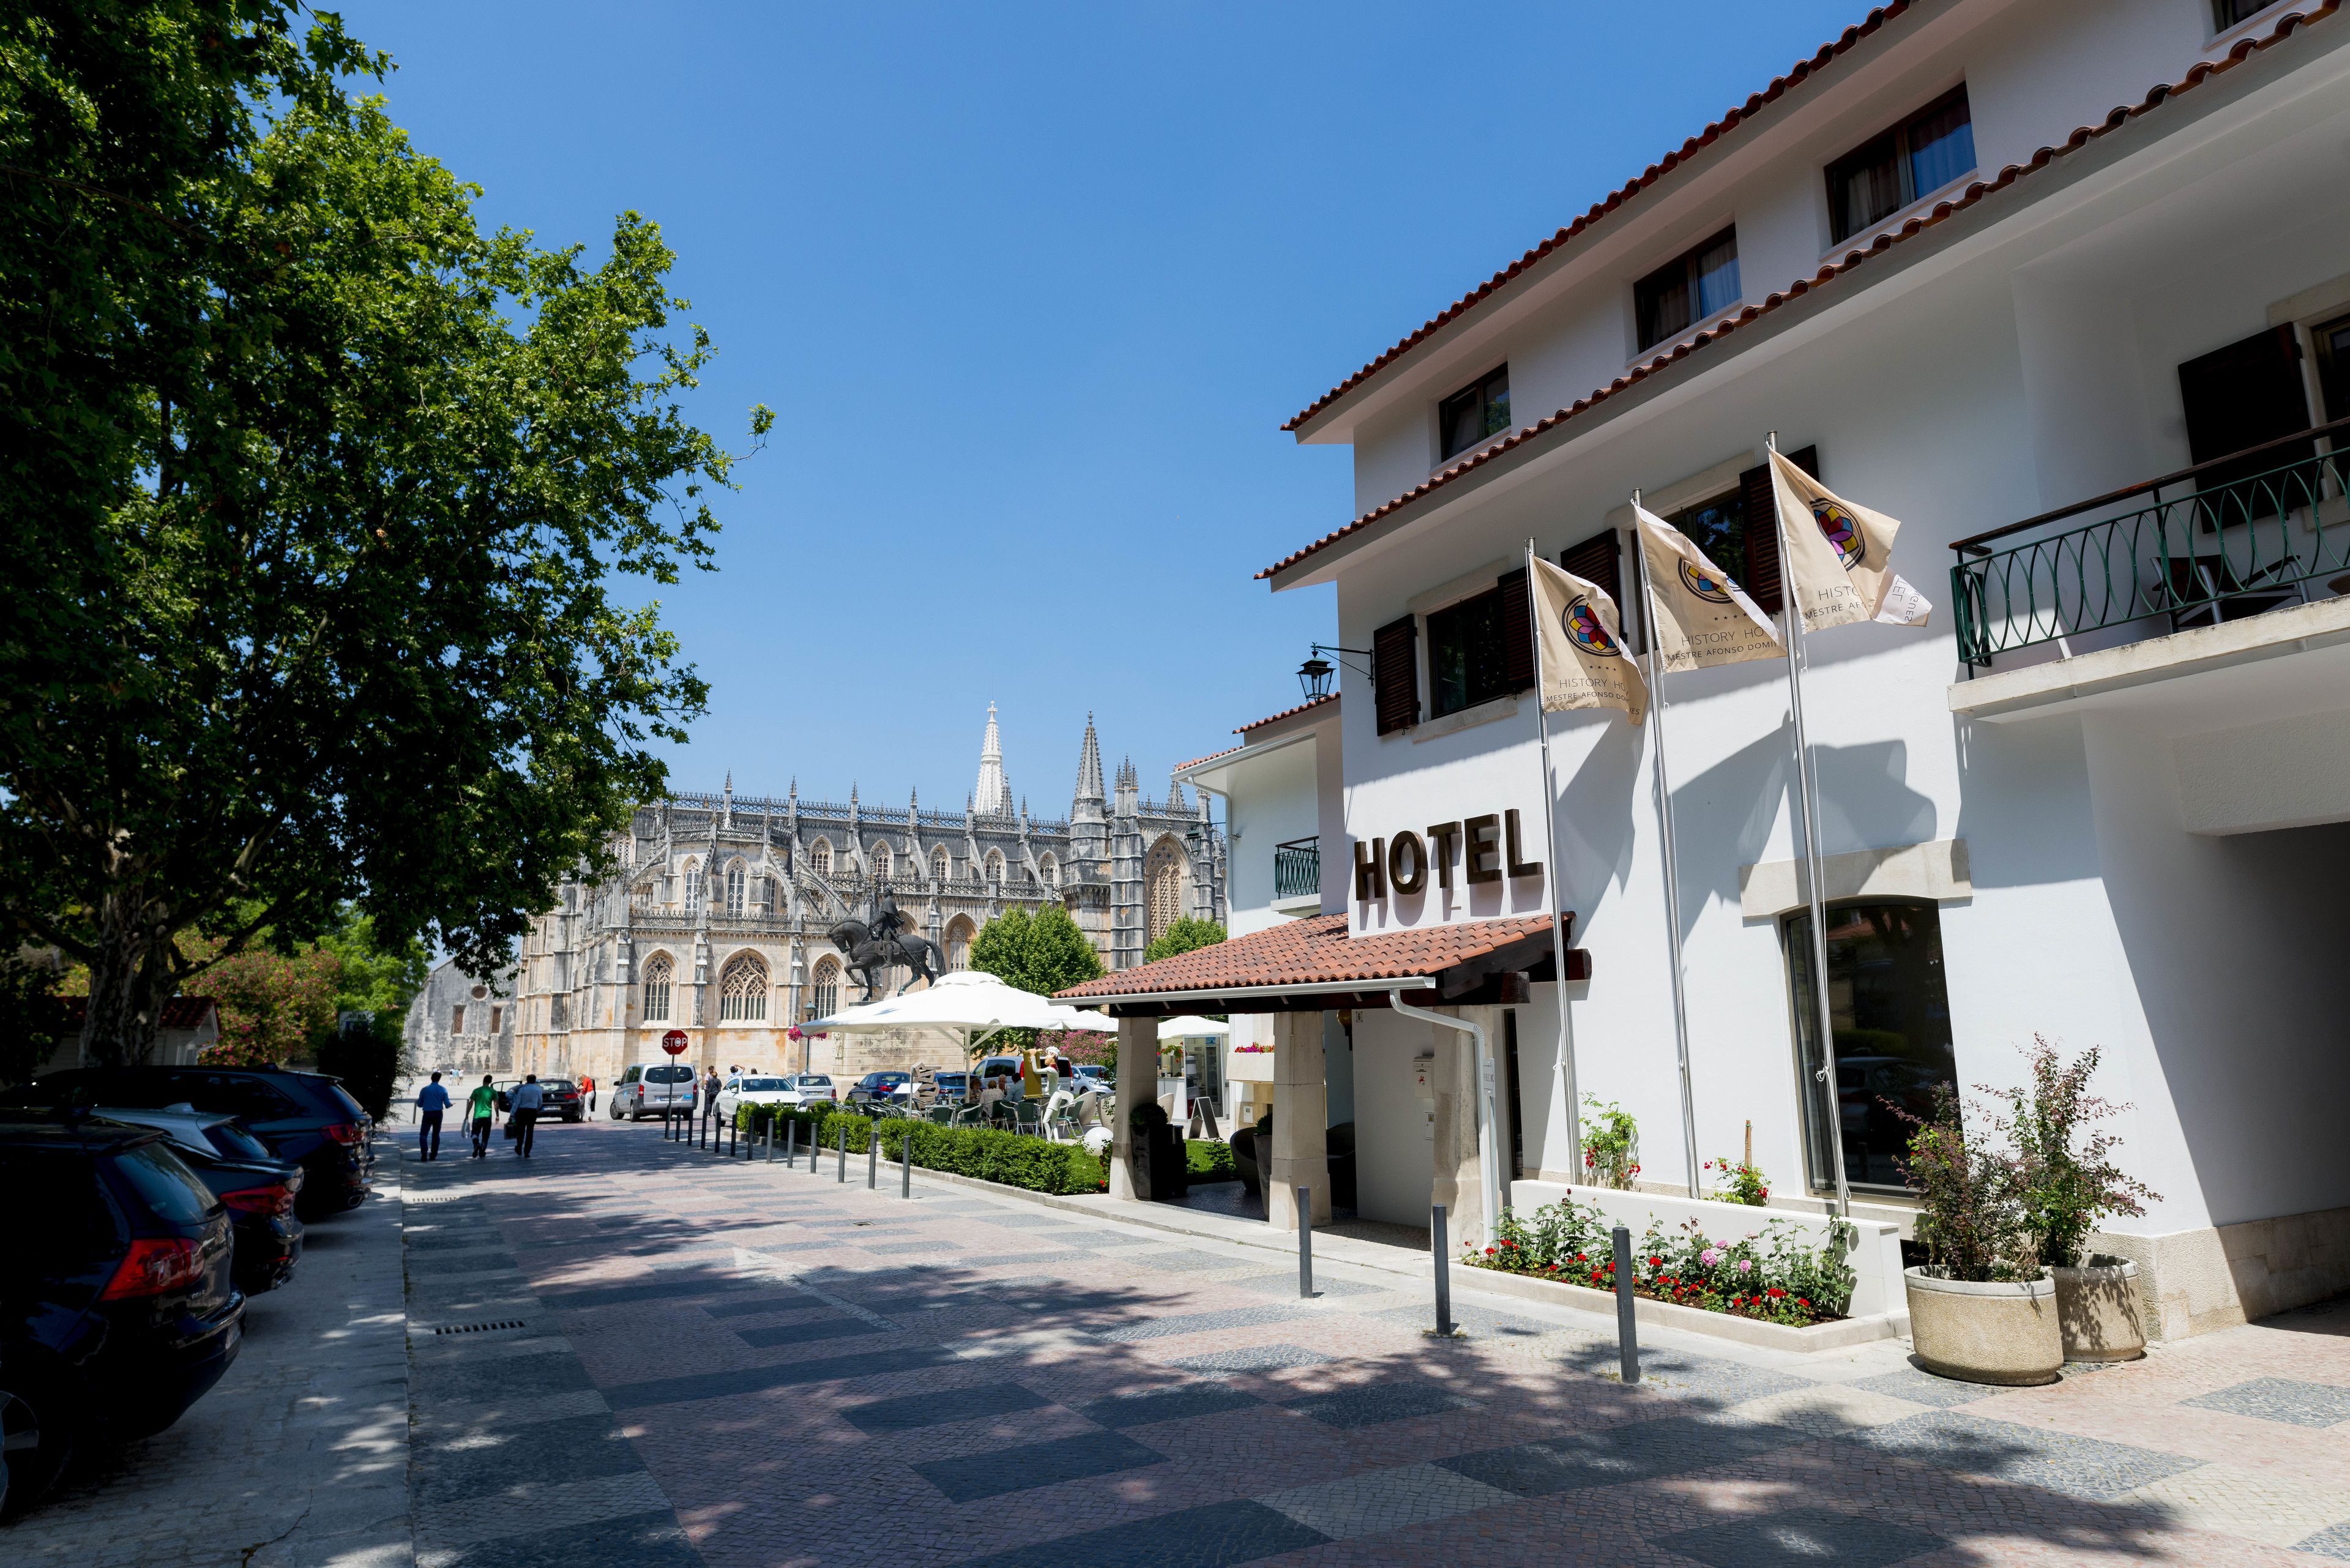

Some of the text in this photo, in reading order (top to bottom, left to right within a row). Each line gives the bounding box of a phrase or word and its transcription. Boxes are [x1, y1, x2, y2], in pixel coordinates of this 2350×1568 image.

[1805, 603, 1843, 619] MESTRE
[1681, 631, 1736, 646] HISTORY
[1667, 651, 1702, 662] MESTRE
[1706, 646, 1744, 656] AFONSO
[1559, 678, 1627, 692] HISTORY HO
[1546, 692, 1577, 702] MESTRE
[1354, 808, 1543, 901] HOTEL
[663, 1037, 687, 1047] STOP
